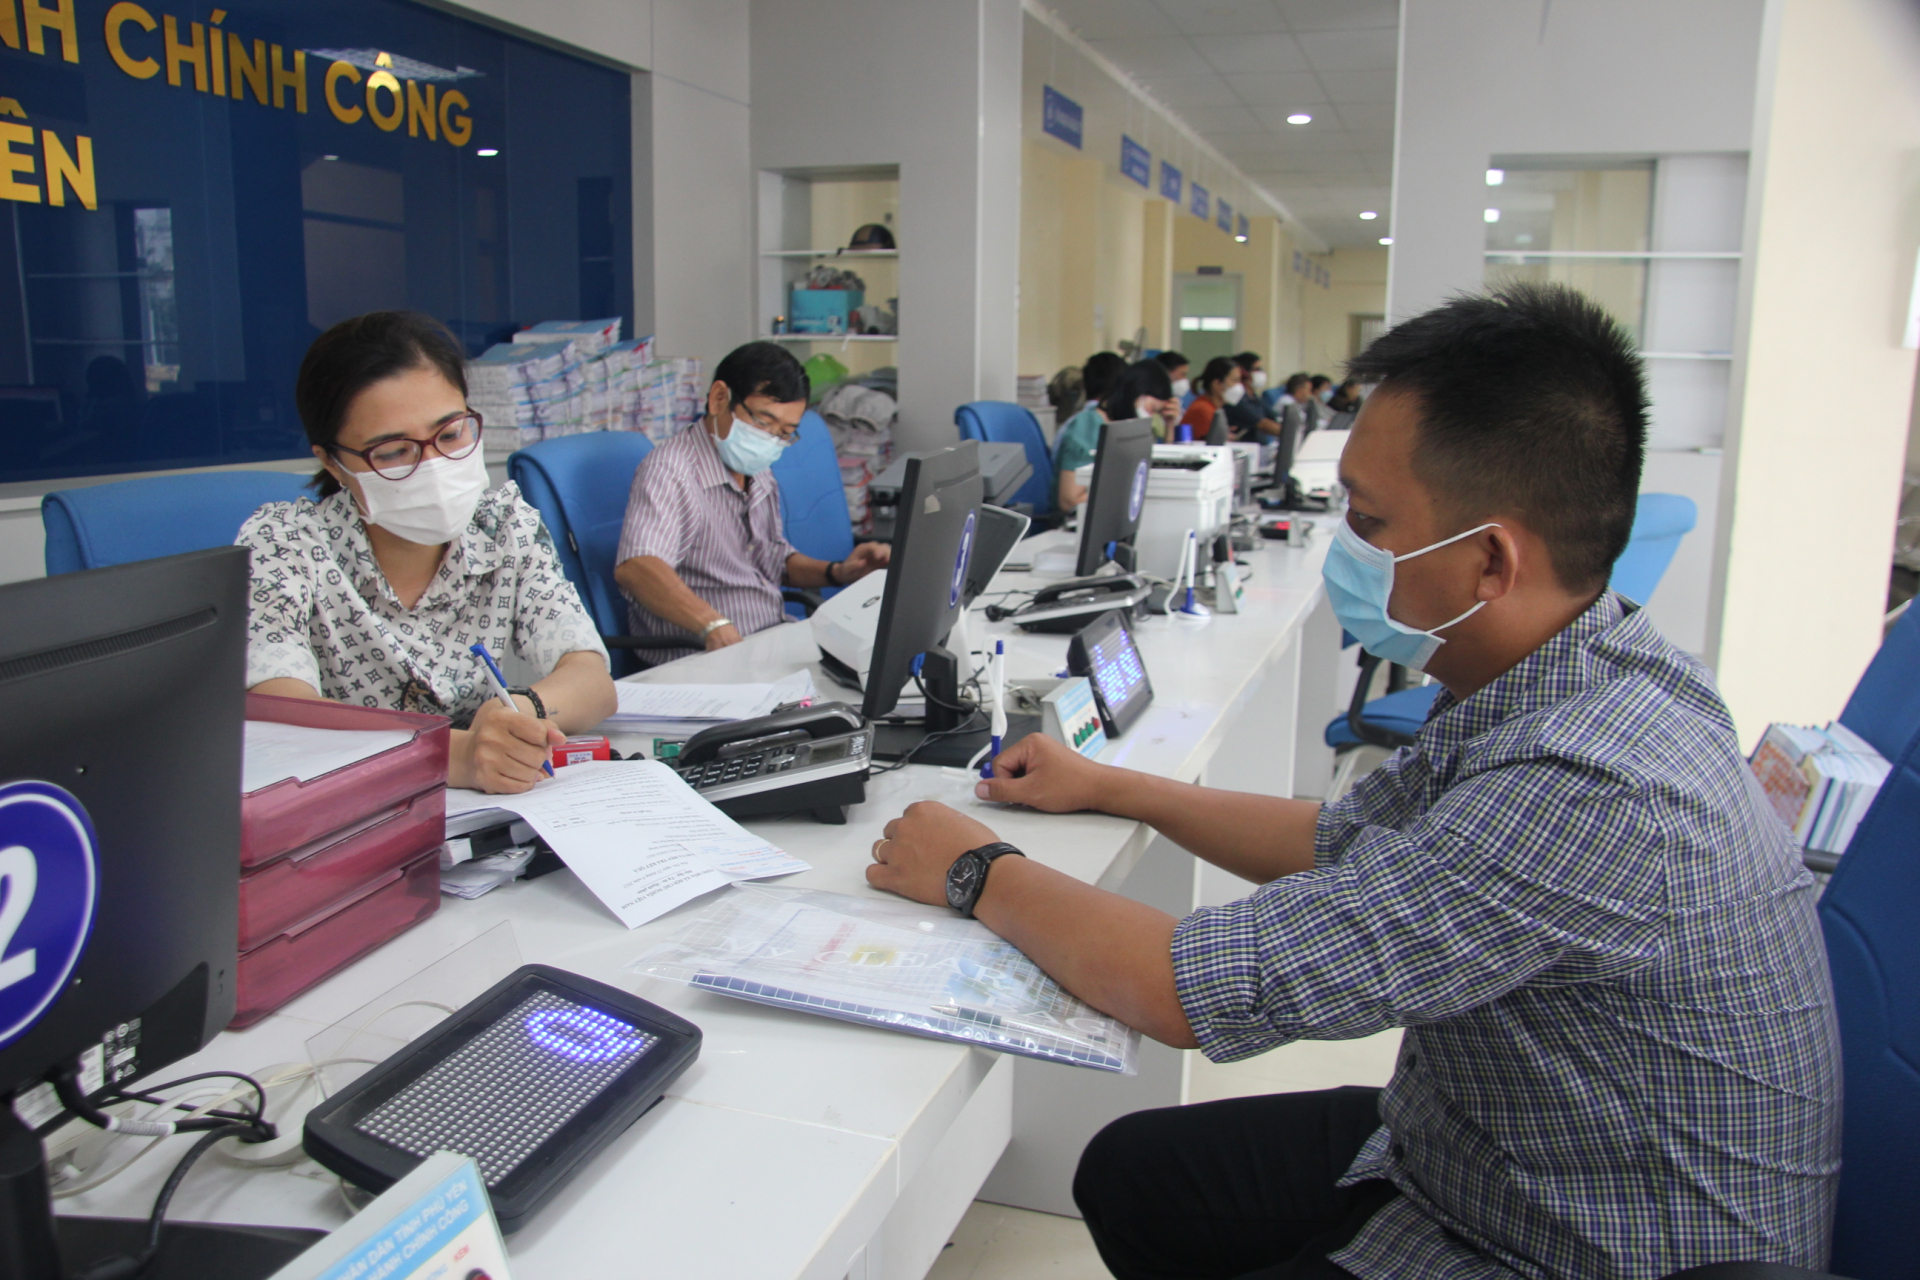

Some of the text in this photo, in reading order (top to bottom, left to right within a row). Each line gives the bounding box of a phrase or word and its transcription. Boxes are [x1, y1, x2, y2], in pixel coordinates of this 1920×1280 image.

[104, 1, 308, 115] CHÍNH
[324, 51, 474, 148] CÔNG
[0, 845, 38, 992] 2
[813, 948, 1014, 991] CLEAR
[983, 994, 1107, 1037] BAG
[445, 1178, 468, 1203] YÊN
[437, 1199, 470, 1231] CÔNG
